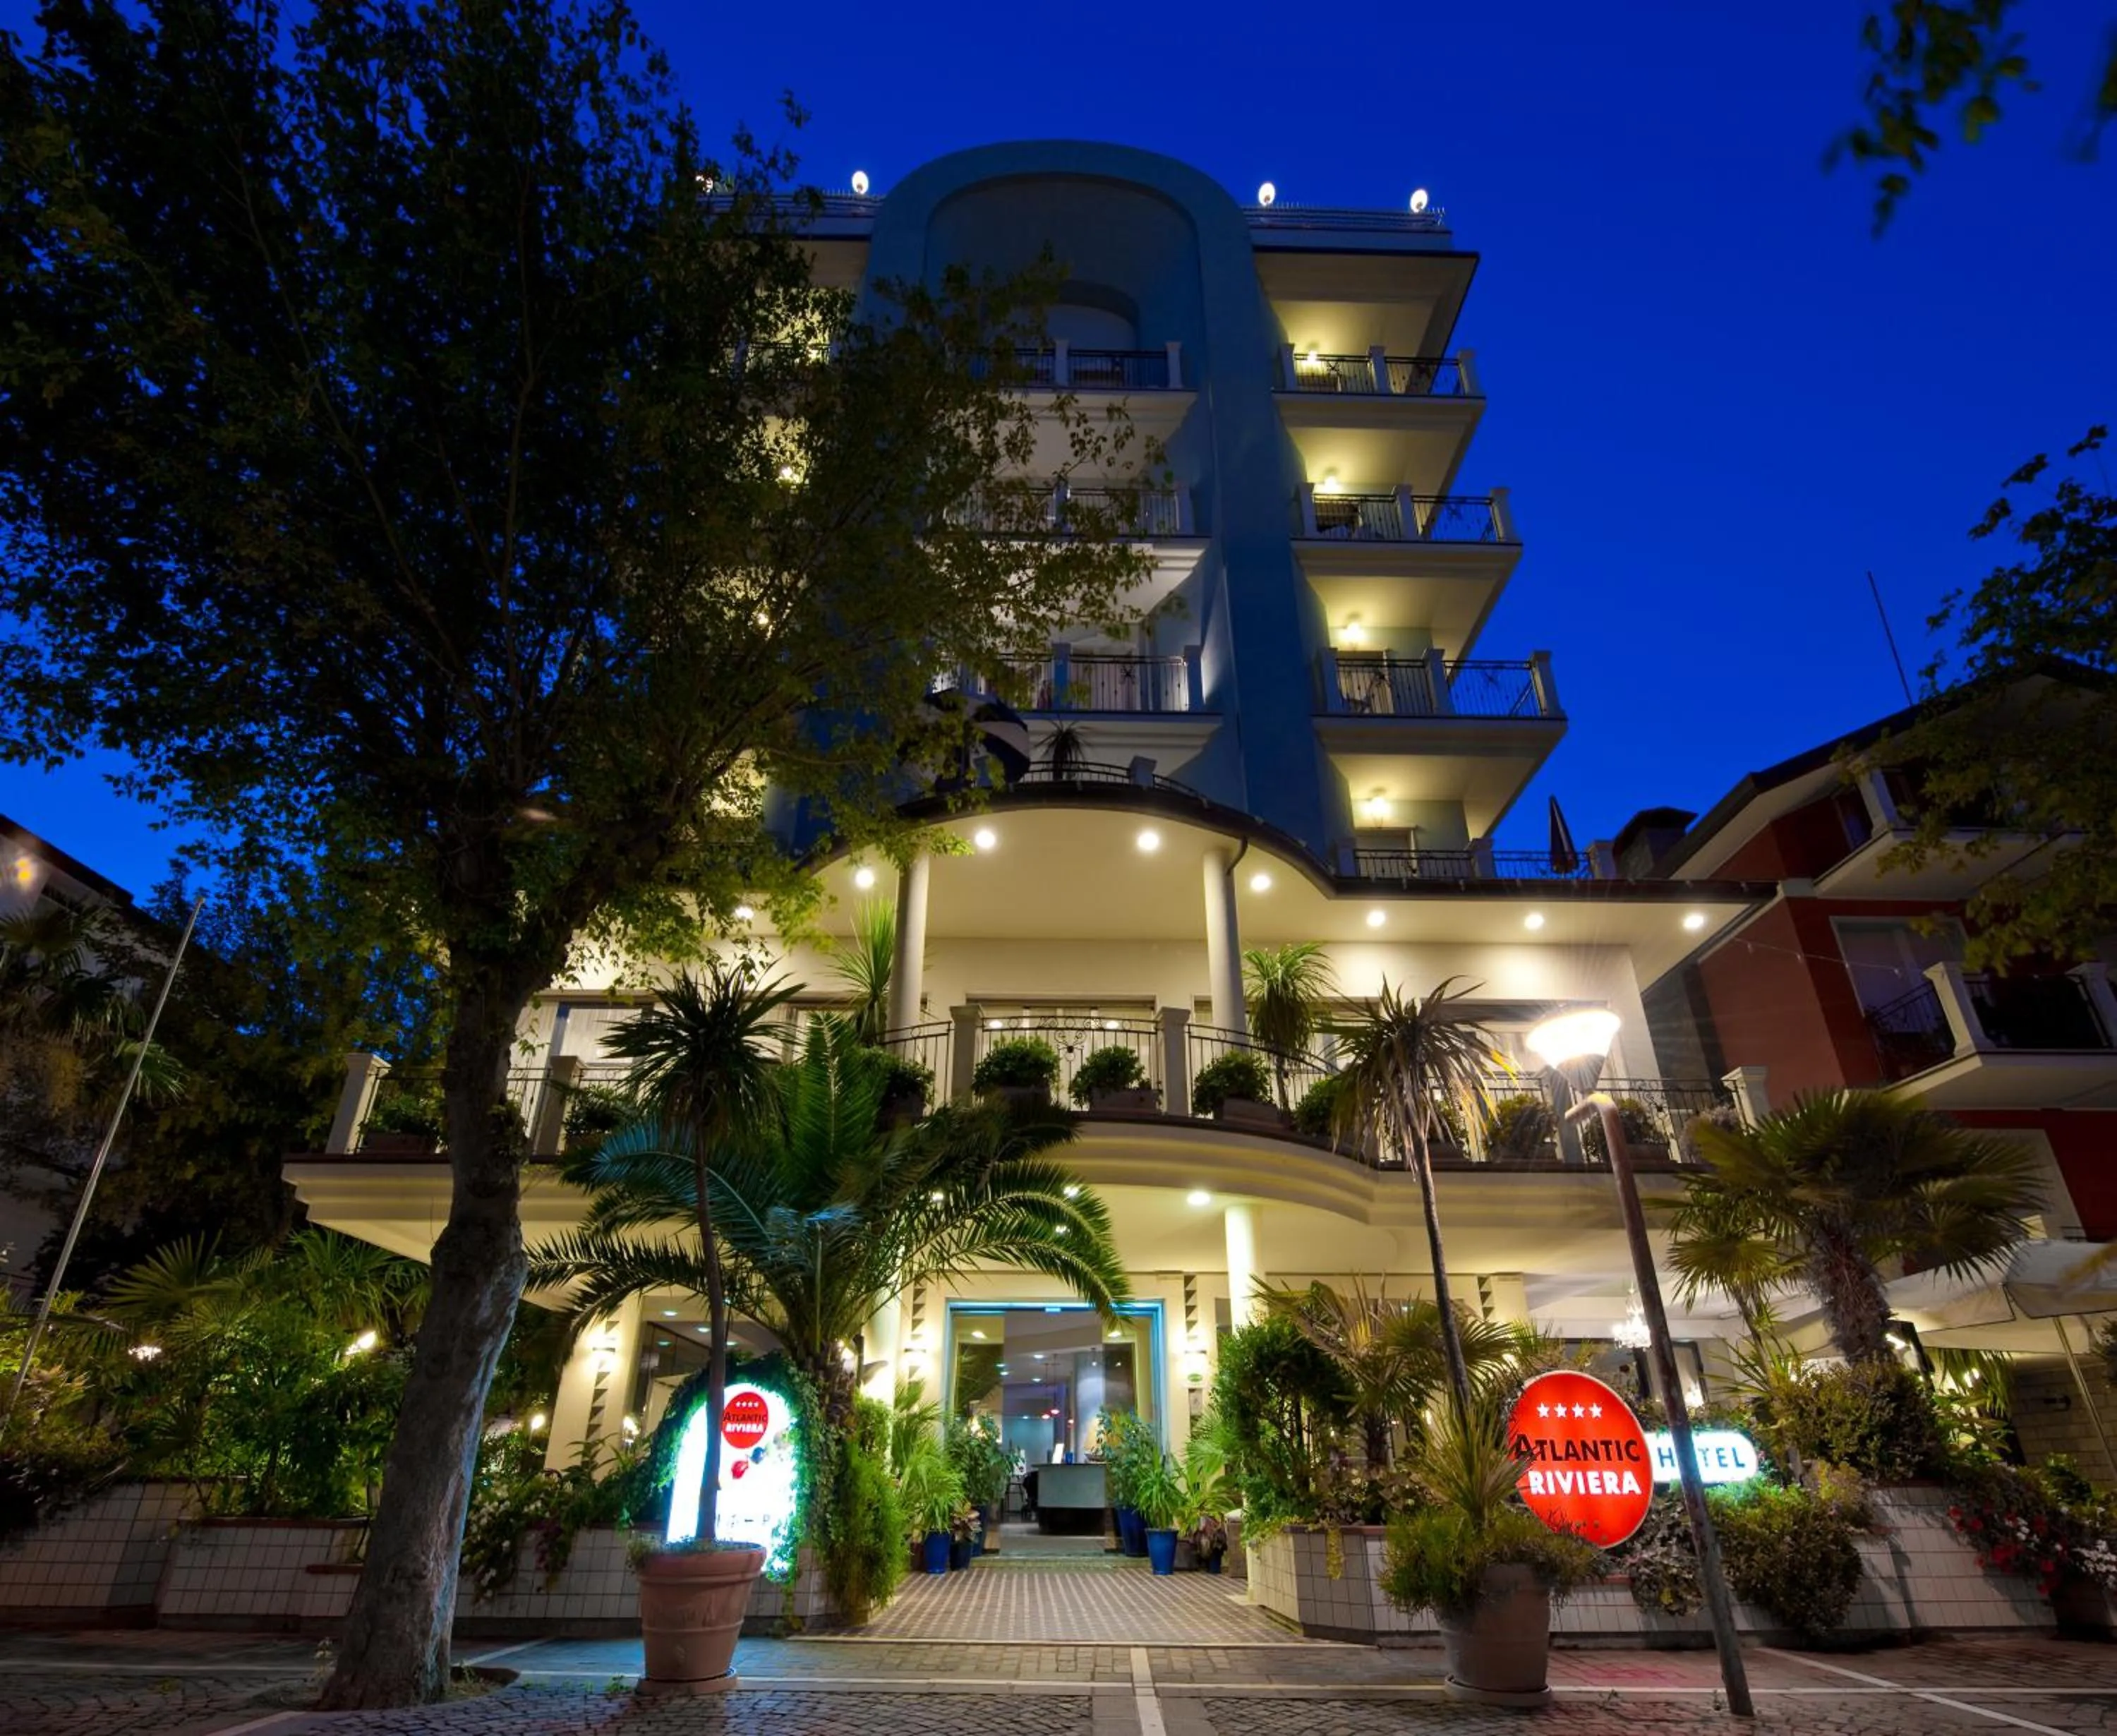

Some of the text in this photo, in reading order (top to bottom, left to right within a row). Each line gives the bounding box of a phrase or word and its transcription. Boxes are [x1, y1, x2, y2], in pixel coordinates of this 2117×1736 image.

[1515, 1434, 1641, 1461] ATLANTIC
[1657, 1447, 1746, 1468] HTEL
[1528, 1470, 1642, 1495] RIVIERA
